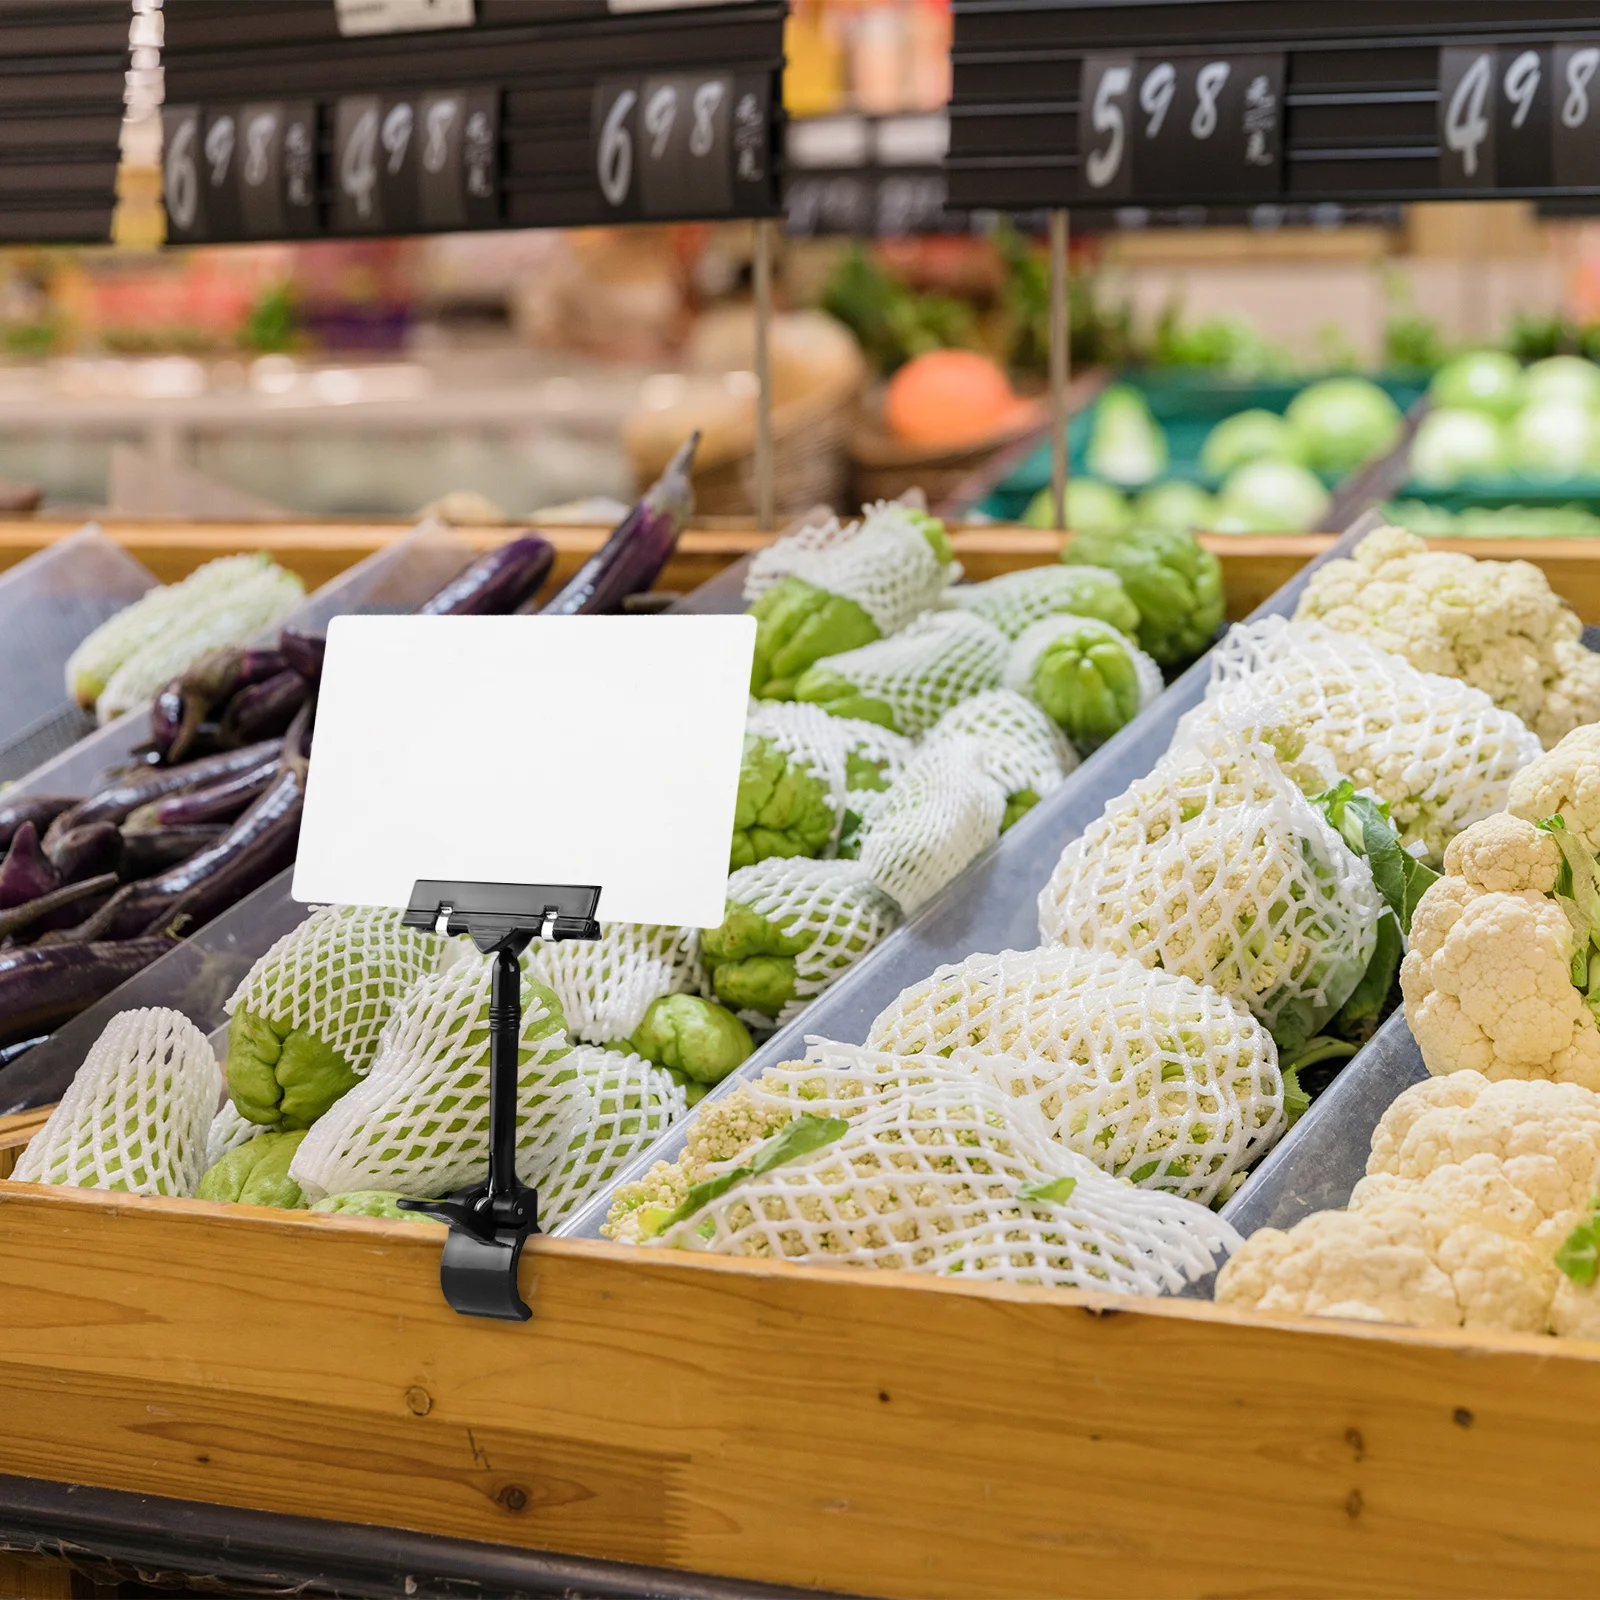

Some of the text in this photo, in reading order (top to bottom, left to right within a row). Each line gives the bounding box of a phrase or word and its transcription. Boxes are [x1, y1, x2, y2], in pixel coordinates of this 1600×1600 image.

[166, 113, 276, 230] 698
[341, 101, 457, 219] 498
[597, 80, 725, 206] 698
[1086, 61, 1231, 188] 598
[1445, 48, 1600, 177] 498
